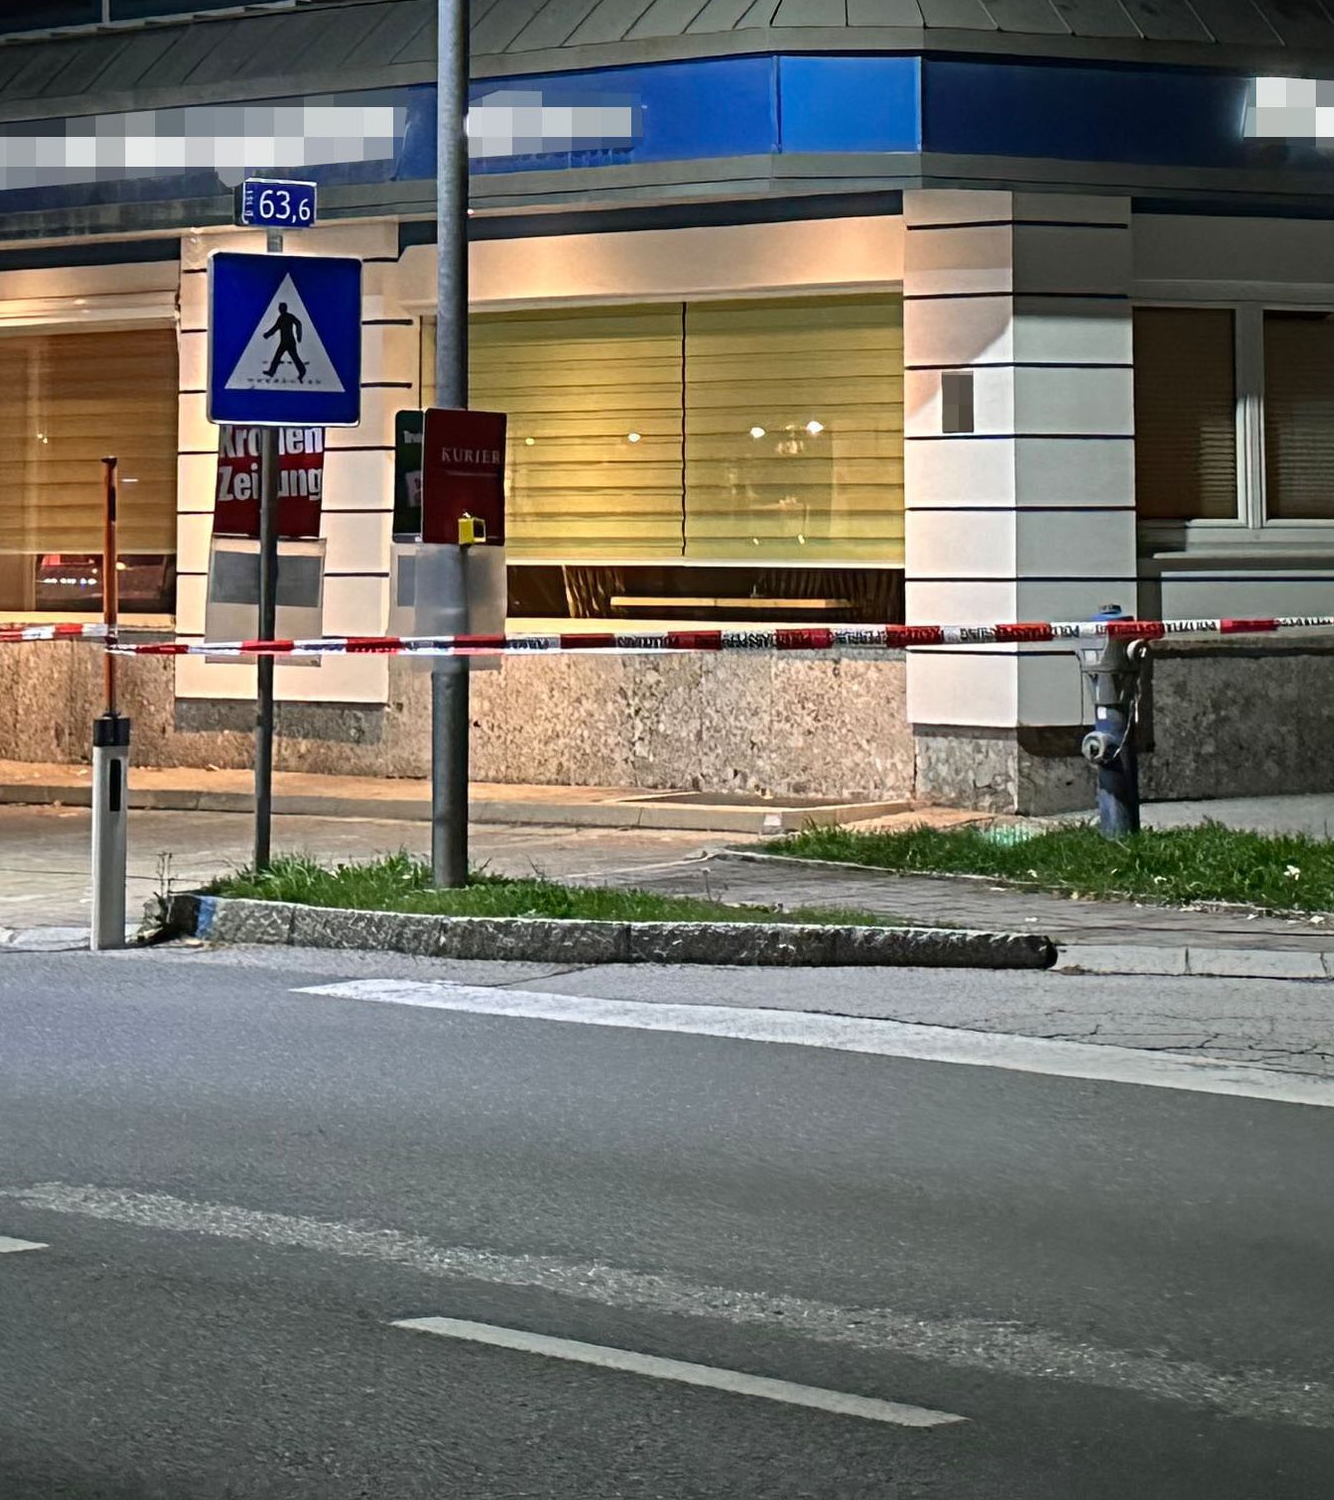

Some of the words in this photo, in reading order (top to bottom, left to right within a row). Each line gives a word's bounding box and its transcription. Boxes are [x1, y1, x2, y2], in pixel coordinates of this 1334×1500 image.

[259, 189, 311, 223] 63,6
[441, 446, 502, 464] KURIER
[217, 461, 323, 501] Zeiung
